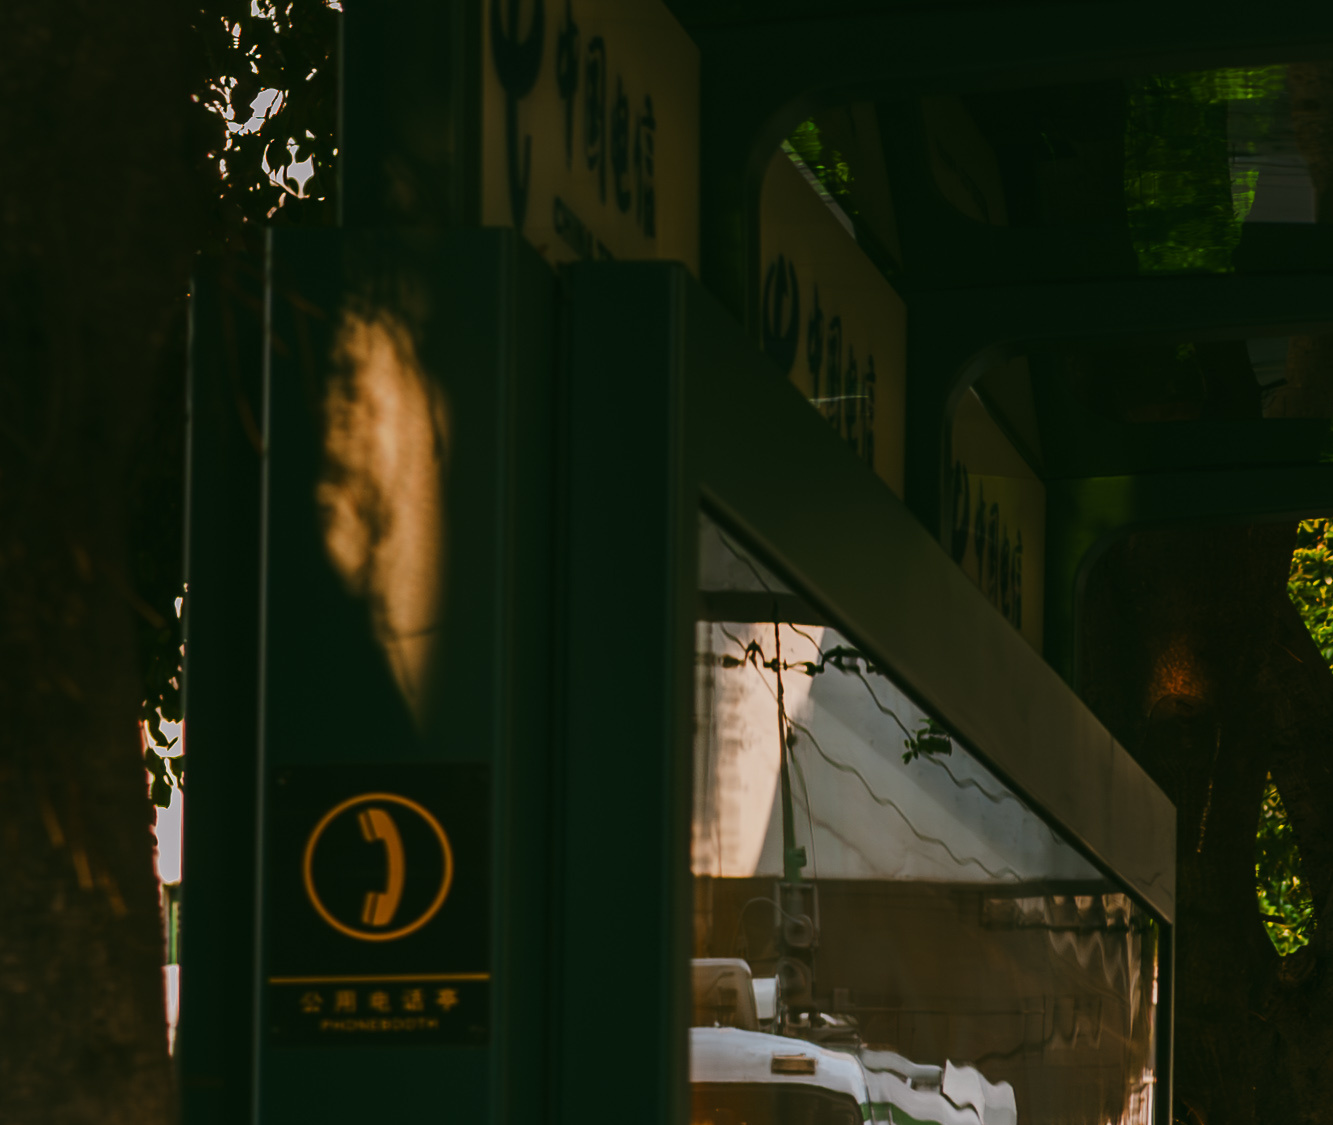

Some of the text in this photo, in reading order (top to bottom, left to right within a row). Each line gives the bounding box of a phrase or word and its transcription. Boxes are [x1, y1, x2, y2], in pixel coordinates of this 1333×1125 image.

[555, 0, 656, 240] 中国电信
[300, 988, 461, 1014] 公用电话亭
